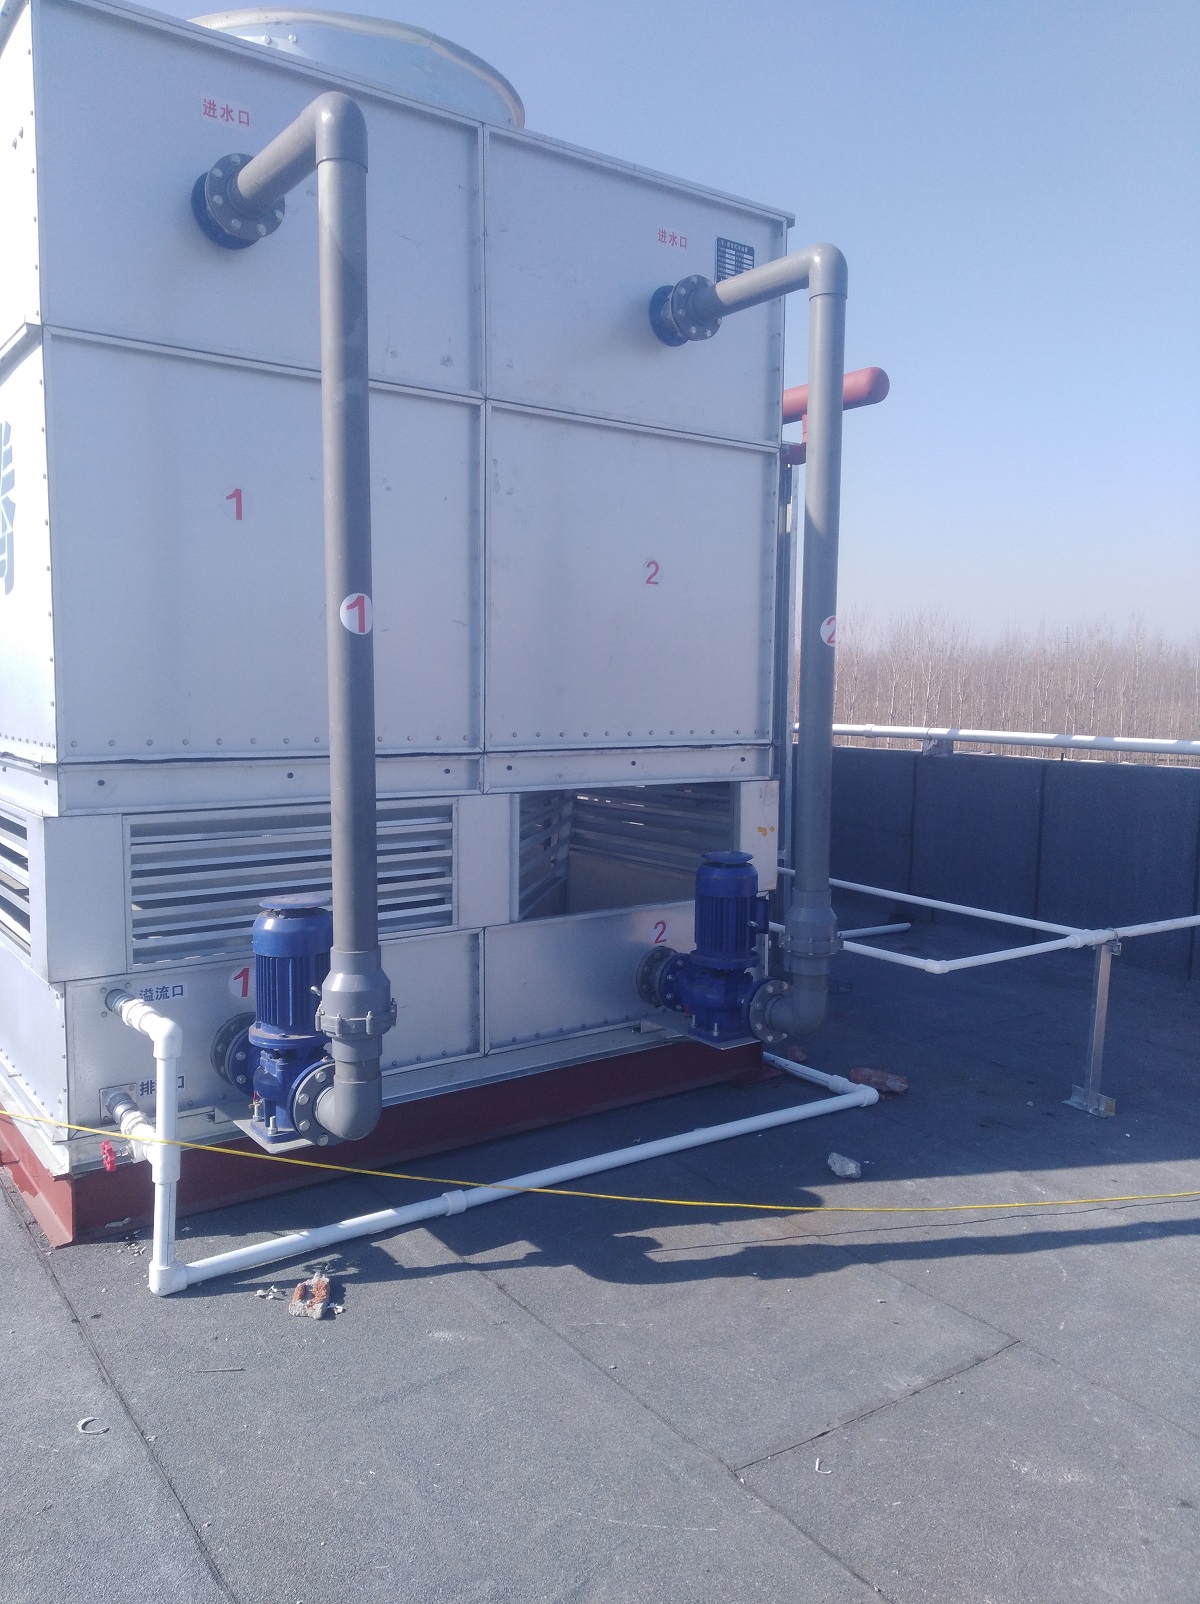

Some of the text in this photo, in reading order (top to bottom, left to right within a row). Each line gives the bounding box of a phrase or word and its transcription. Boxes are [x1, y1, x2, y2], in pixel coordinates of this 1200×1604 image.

[203, 99, 250, 126] 进水口
[658, 228, 687, 249] 进水口
[226, 488, 242, 520] 1
[645, 561, 660, 585] 2
[346, 595, 365, 633] 1
[826, 617, 836, 644] 2
[653, 920, 667, 945] 2
[139, 984, 184, 1002] 溢流口
[233, 967, 250, 998] 1
[140, 1075, 184, 1096] 排口
